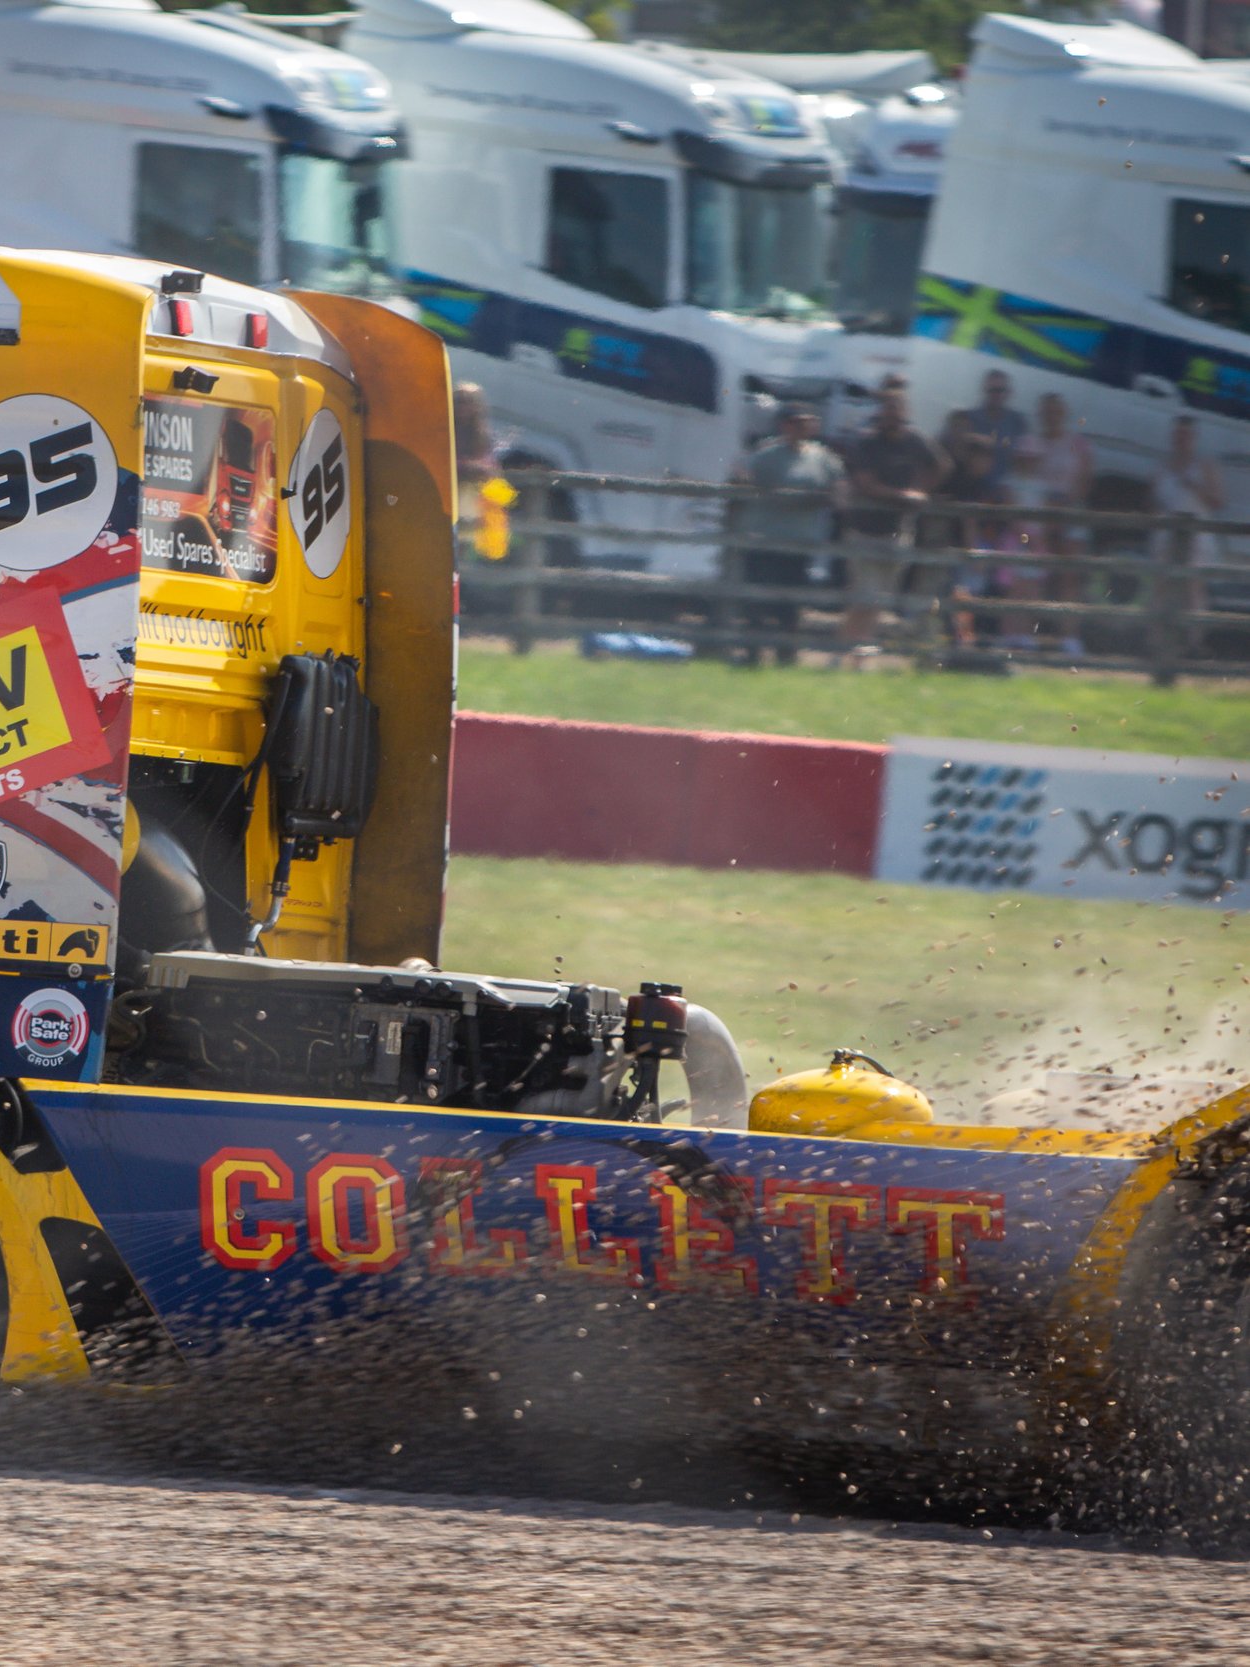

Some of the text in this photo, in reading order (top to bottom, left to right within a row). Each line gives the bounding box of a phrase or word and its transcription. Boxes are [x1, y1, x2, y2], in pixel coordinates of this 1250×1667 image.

[152, 454, 193, 482] SPARES
[302, 431, 345, 552] 95
[142, 527, 267, 574] Used Spares Specialist
[196, 608, 268, 660] bought
[31, 1017, 70, 1031] Park
[31, 1027, 69, 1041] Safe
[27, 1054, 64, 1067] GROUP
[199, 1146, 1005, 1309] COLLETT
